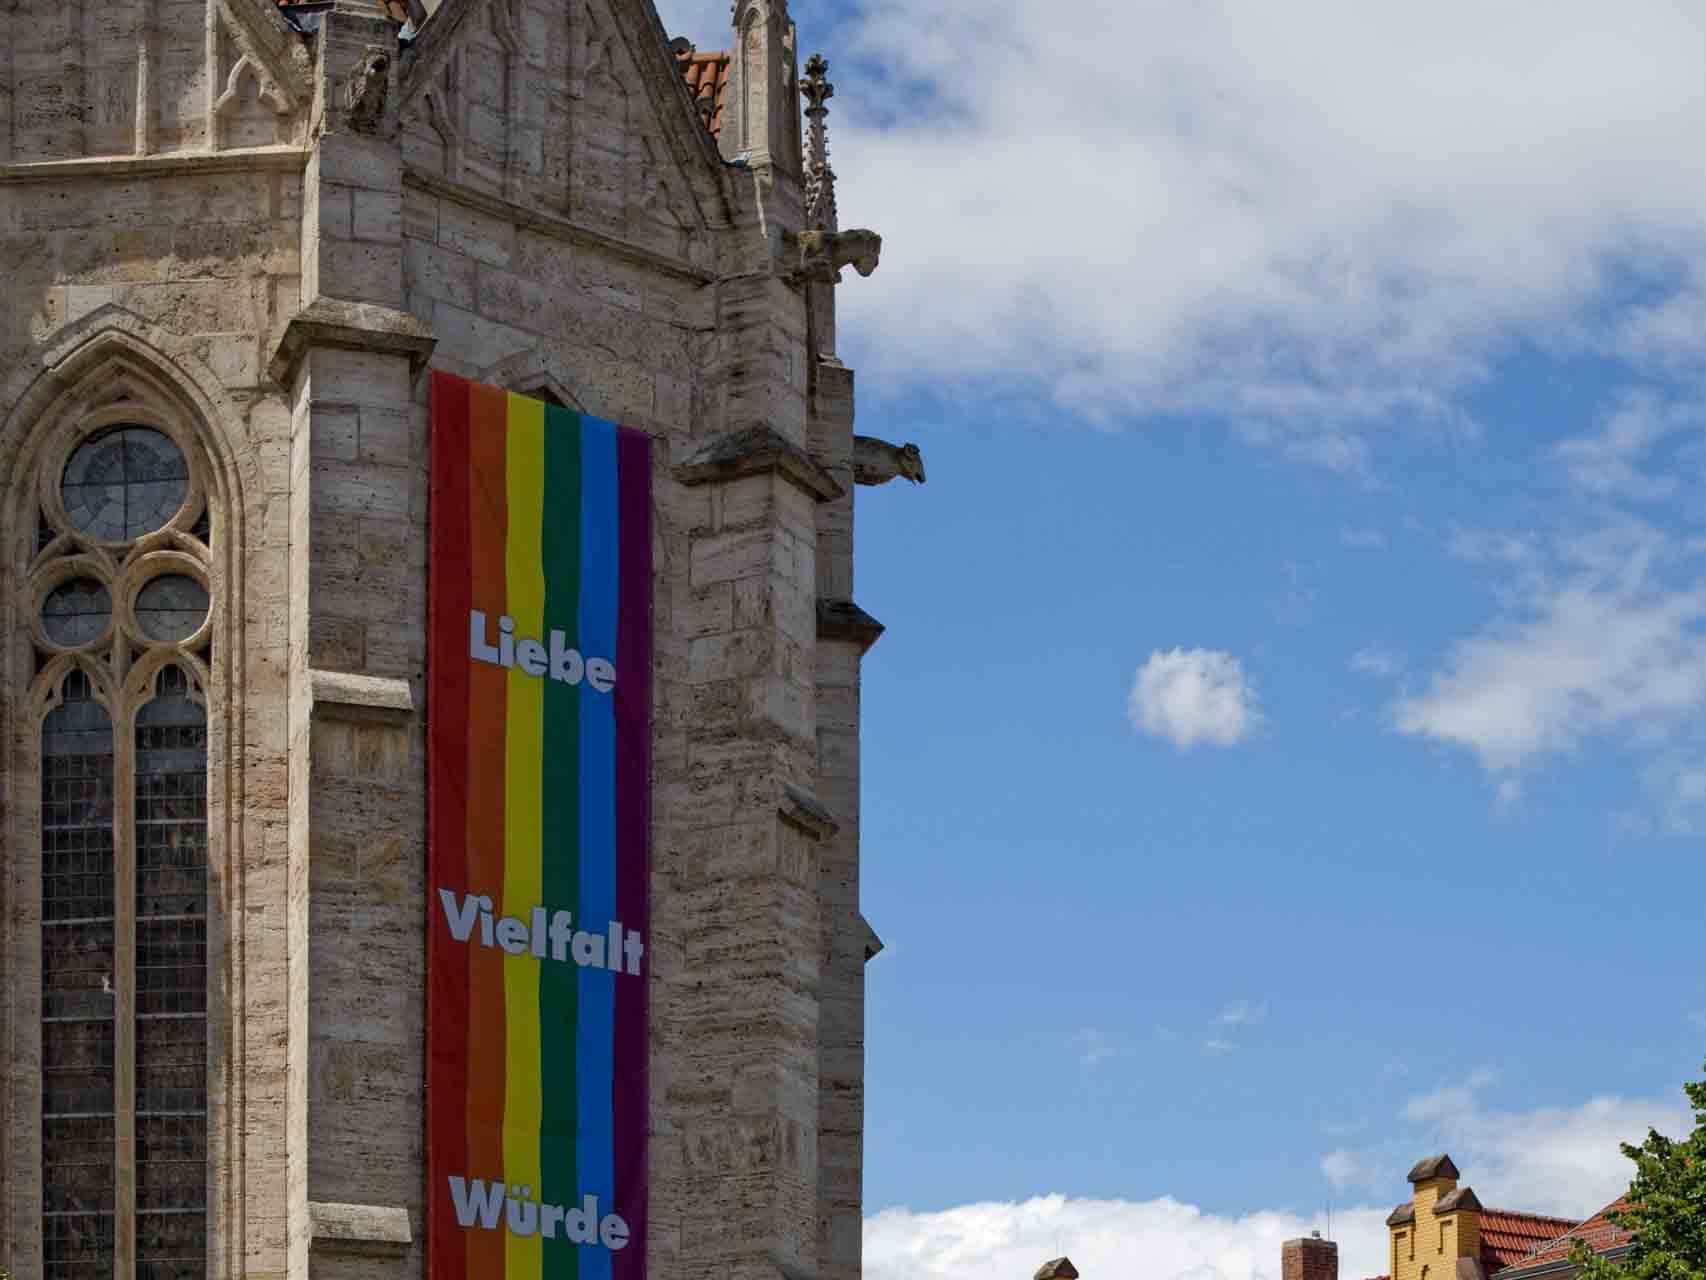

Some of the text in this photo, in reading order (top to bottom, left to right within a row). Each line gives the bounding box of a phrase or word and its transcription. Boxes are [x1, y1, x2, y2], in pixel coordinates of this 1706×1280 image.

[469, 610, 617, 692] Liebe
[438, 888, 644, 976] Vielfalt
[449, 1175, 631, 1250] Würde
